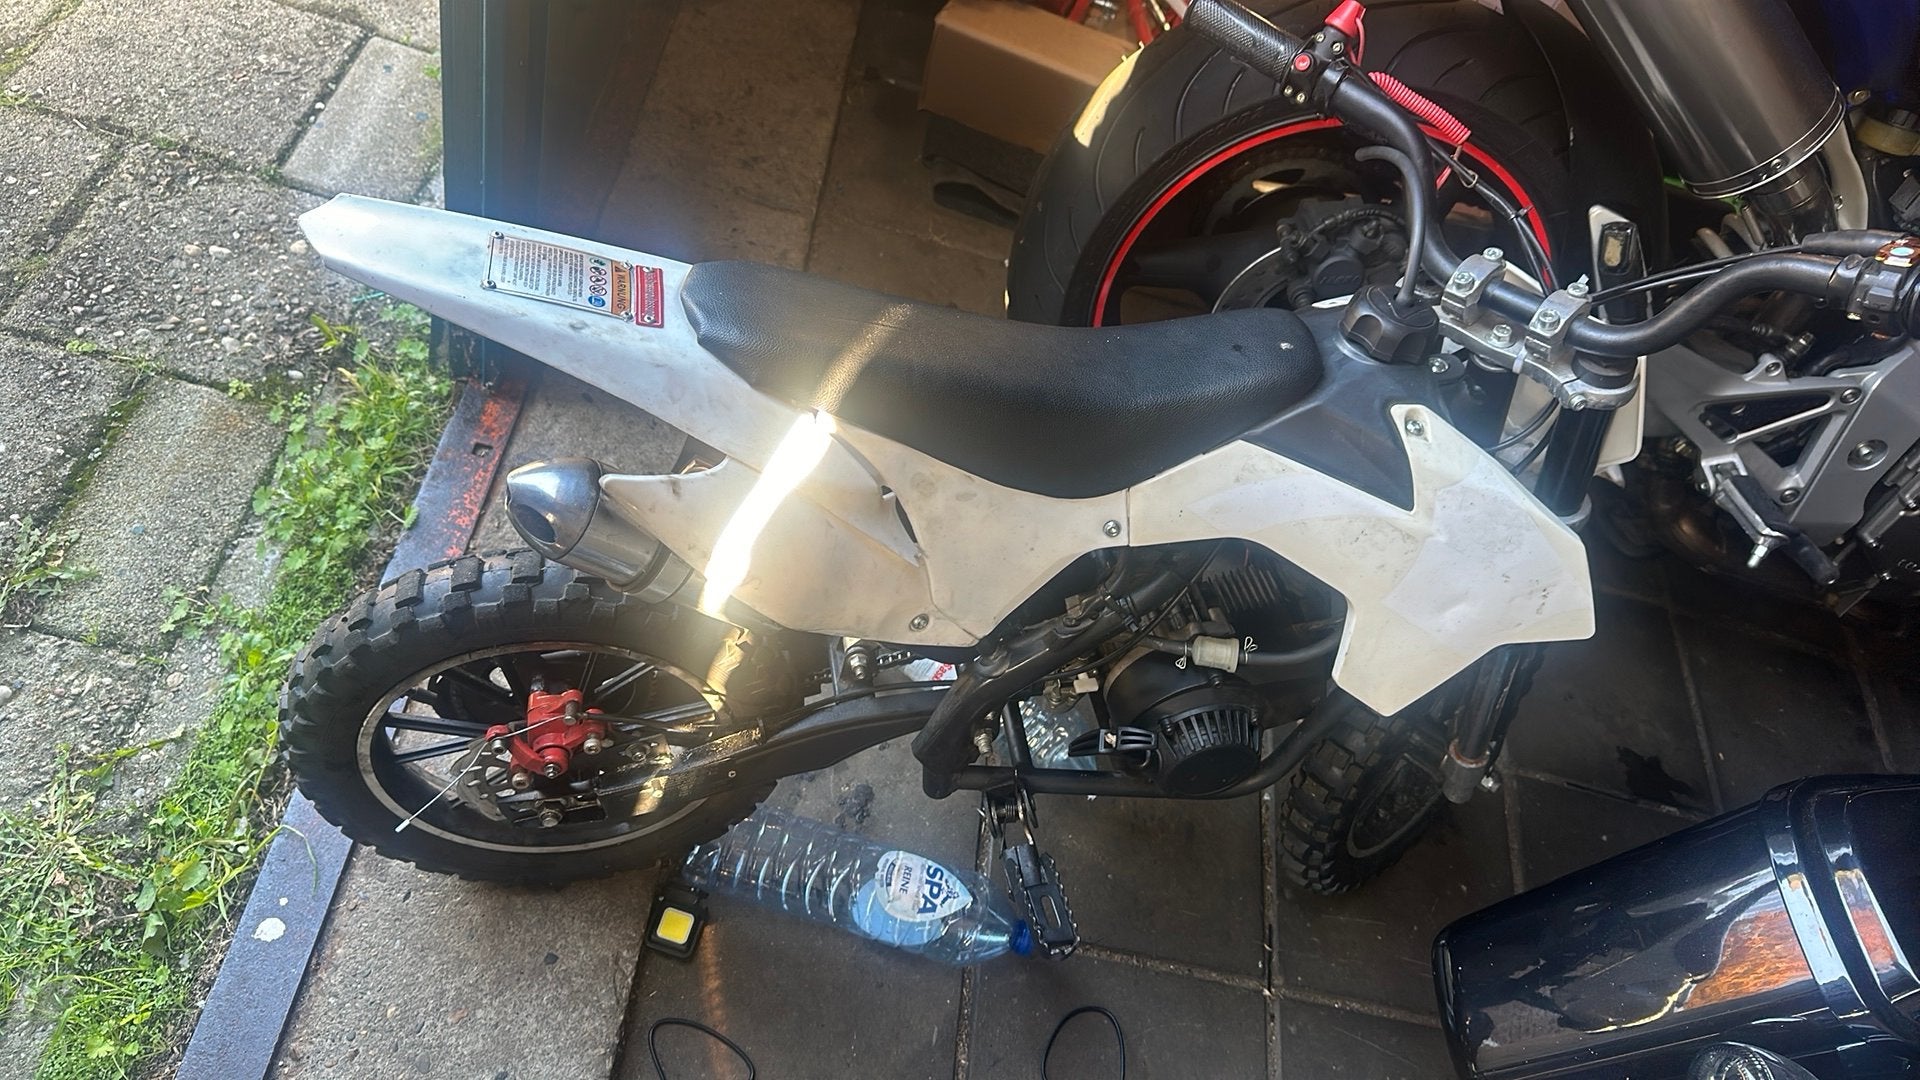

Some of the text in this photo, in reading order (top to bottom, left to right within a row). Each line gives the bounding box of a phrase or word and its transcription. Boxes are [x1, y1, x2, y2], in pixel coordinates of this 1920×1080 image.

[616, 273, 626, 311] WARNUNG
[899, 865, 913, 895] REINE
[917, 865, 944, 914] SPA
